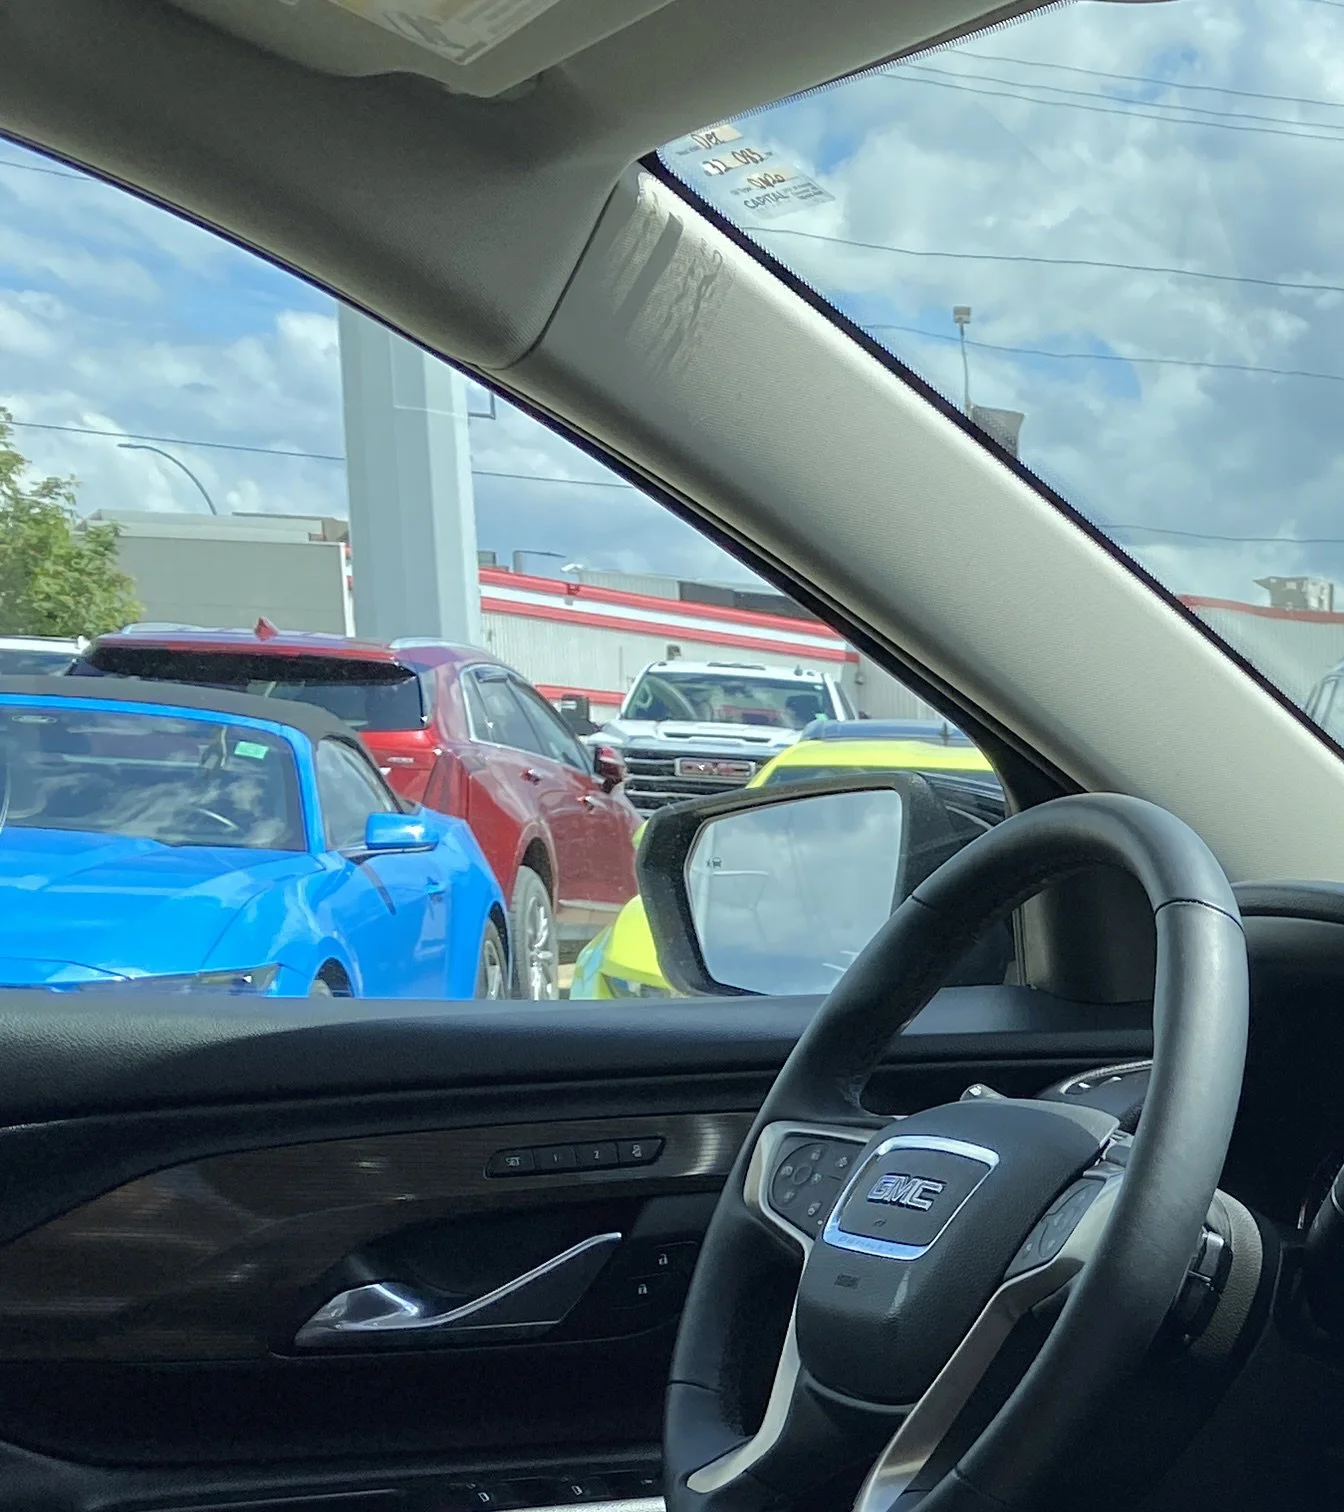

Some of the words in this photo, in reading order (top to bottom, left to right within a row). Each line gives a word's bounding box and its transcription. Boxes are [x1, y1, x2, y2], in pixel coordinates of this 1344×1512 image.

[744, 191, 789, 209] CAPITAL
[505, 1157, 521, 1167] SET
[867, 1172, 948, 1212] GMC
